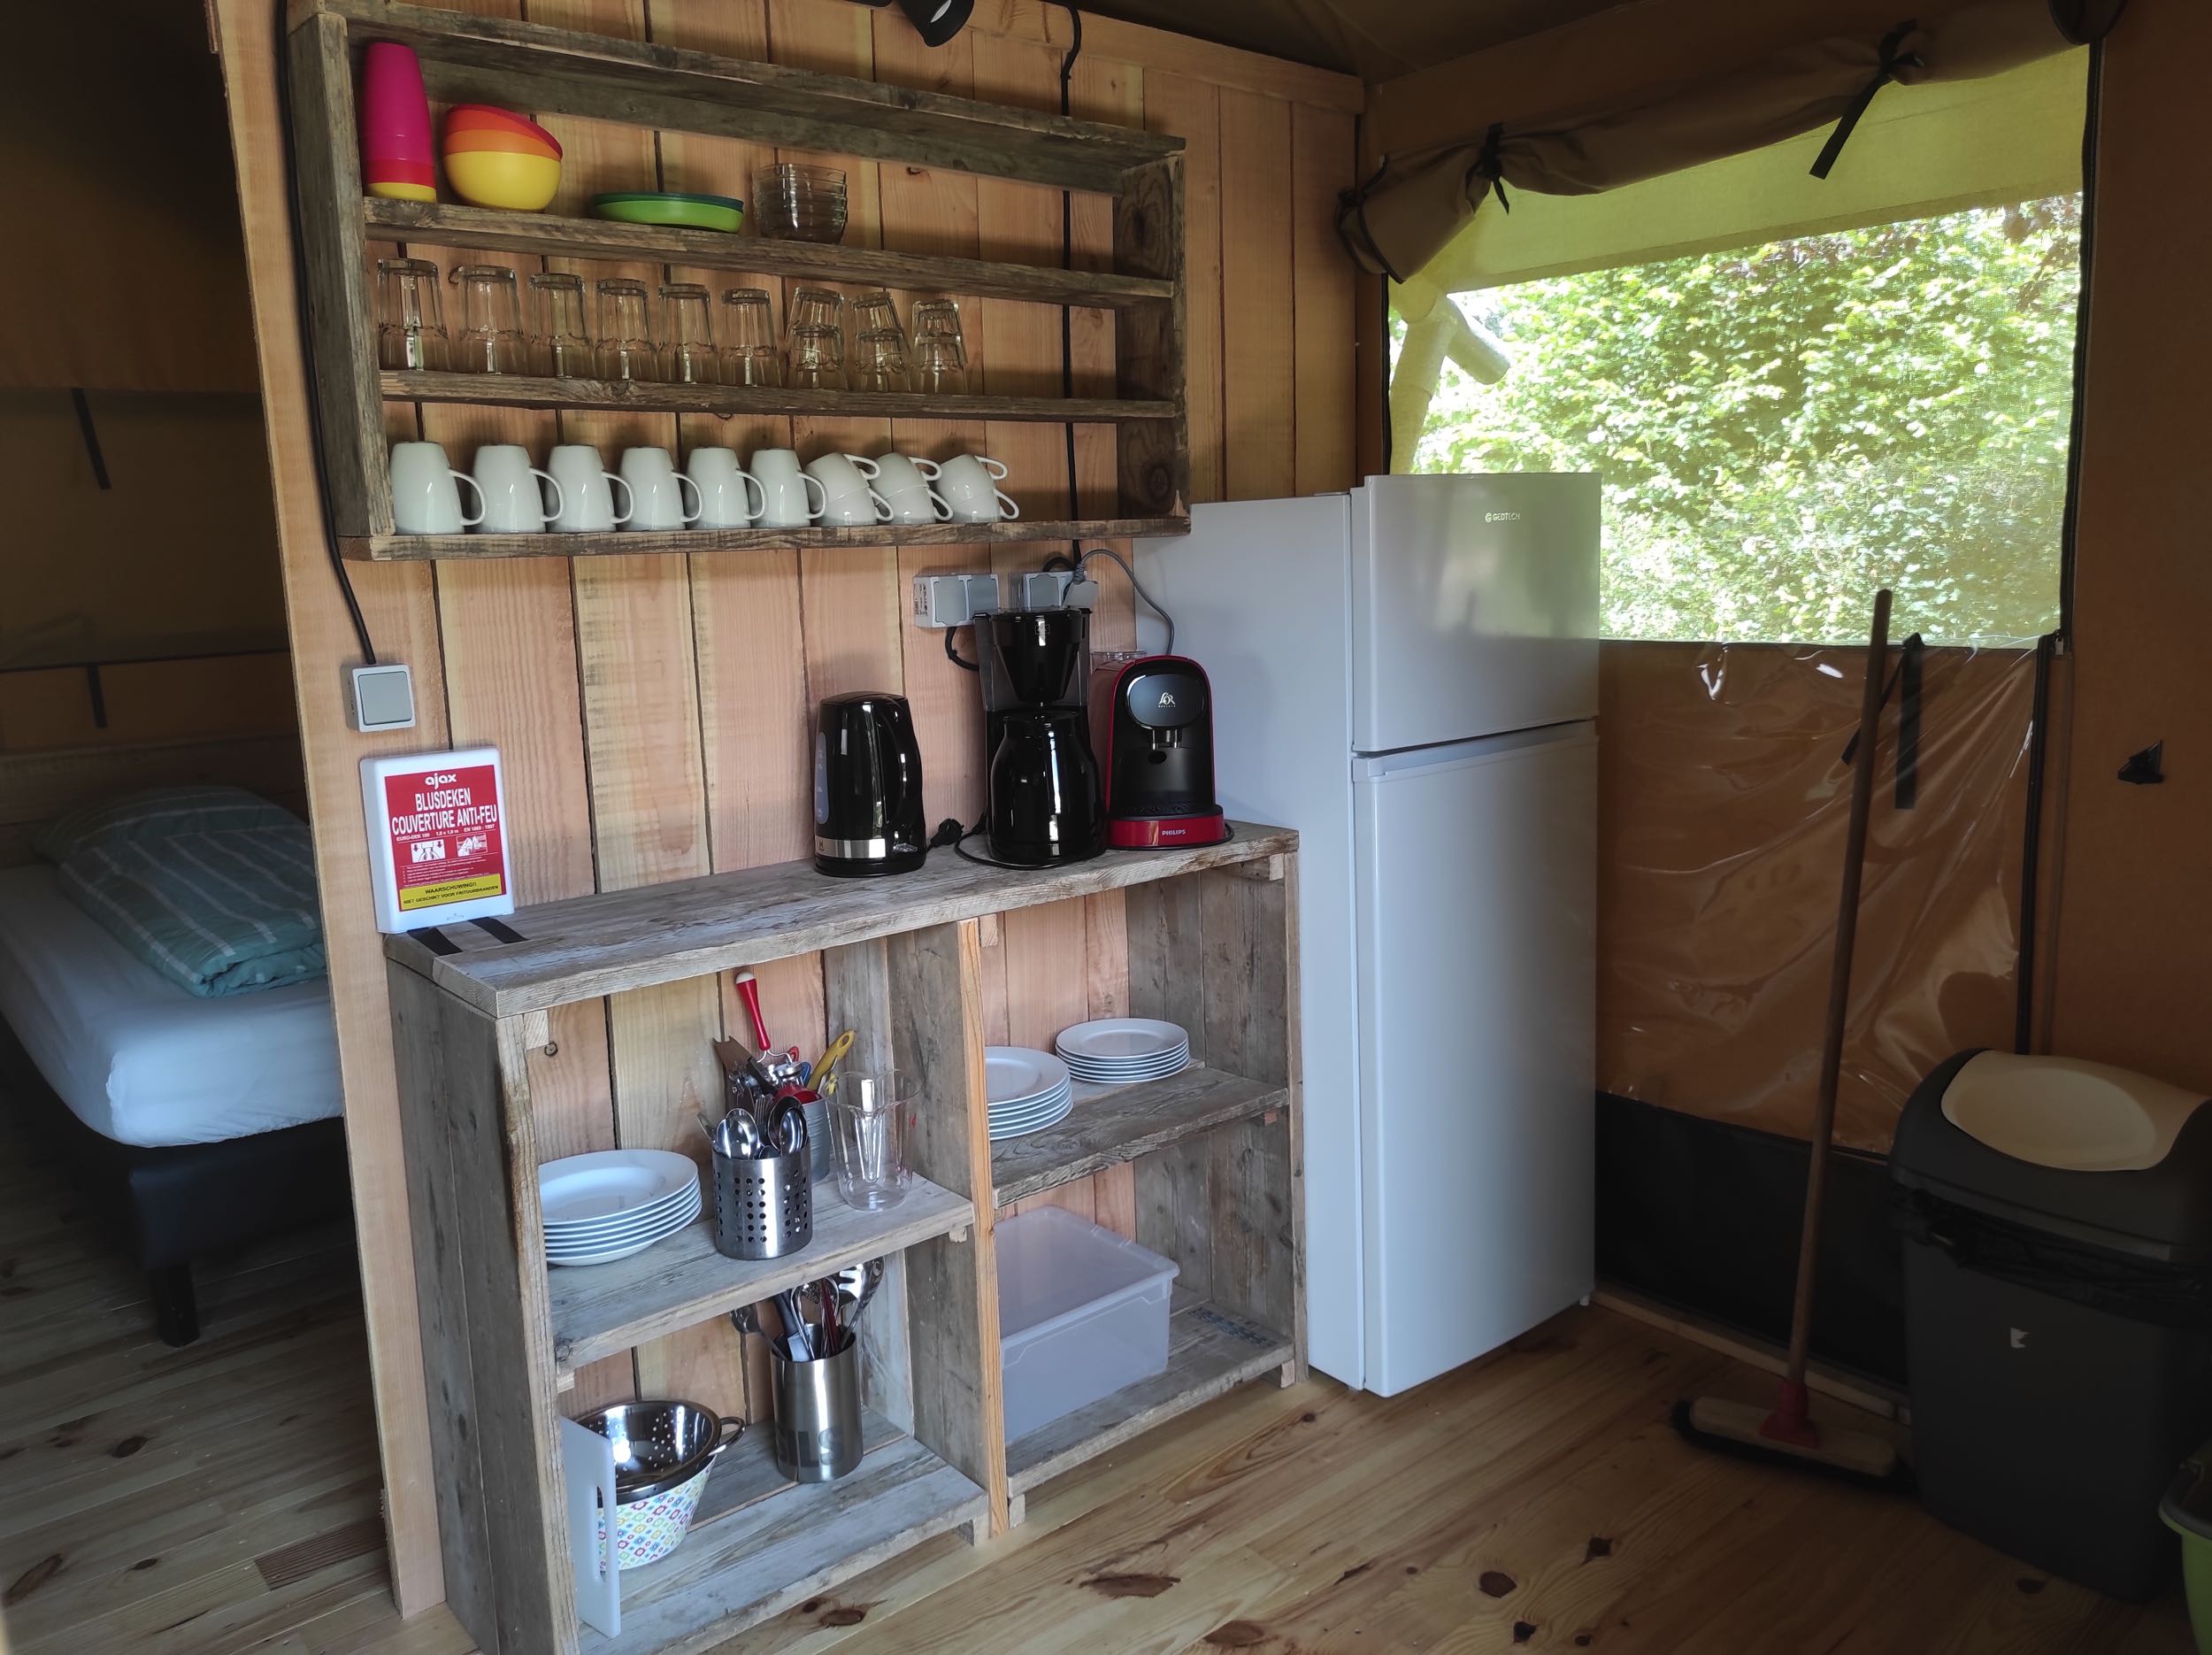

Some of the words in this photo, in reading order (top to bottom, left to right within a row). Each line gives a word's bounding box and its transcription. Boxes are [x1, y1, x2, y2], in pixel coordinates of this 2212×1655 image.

[425, 773, 457, 789] ajax
[415, 788, 472, 812] BLUSDEKEN
[392, 810, 455, 835] COUVERTURE
[457, 804, 497, 827] ANTI-FEU
